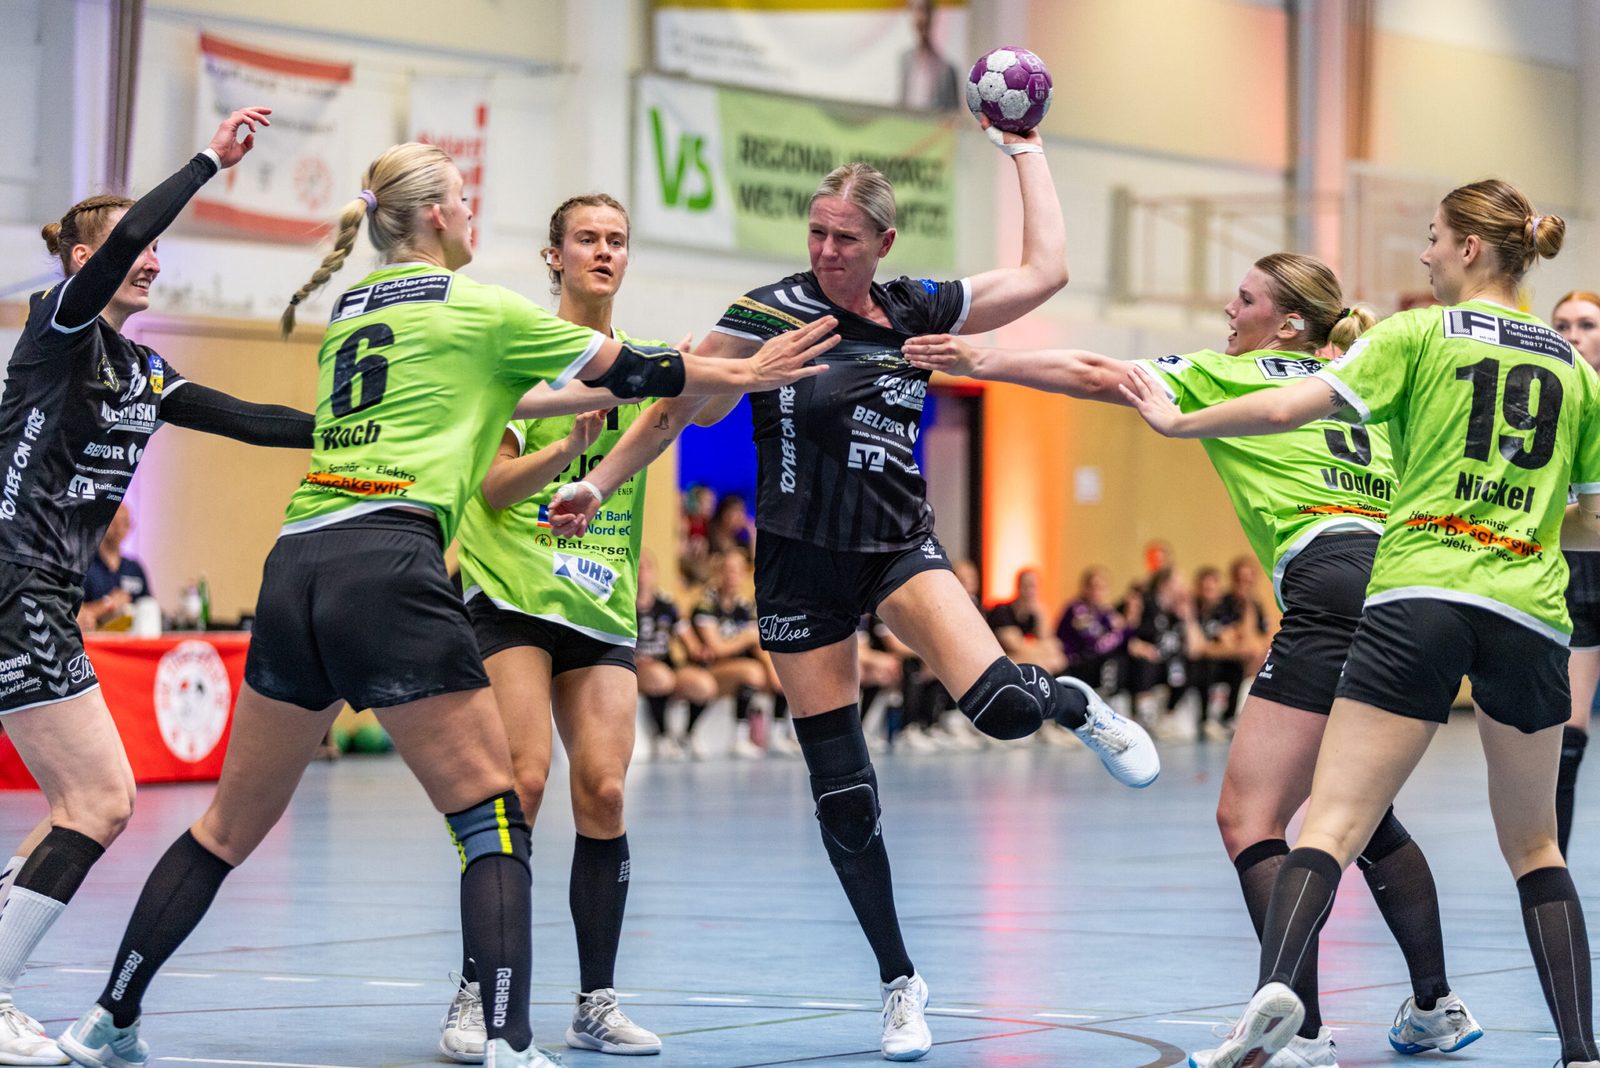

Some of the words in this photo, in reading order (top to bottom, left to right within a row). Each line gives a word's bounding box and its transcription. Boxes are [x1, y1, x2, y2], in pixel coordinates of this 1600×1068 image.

[374, 275, 449, 294] Feddersen
[1502, 319, 1570, 348] Feddersen
[330, 322, 396, 419] 6
[778, 385, 797, 415] FIRE
[1455, 356, 1565, 471] 19
[24, 407, 46, 441] FIRE
[852, 404, 906, 438] BELFOR
[376, 464, 417, 483] Elektro
[1454, 470, 1537, 514] Nickel
